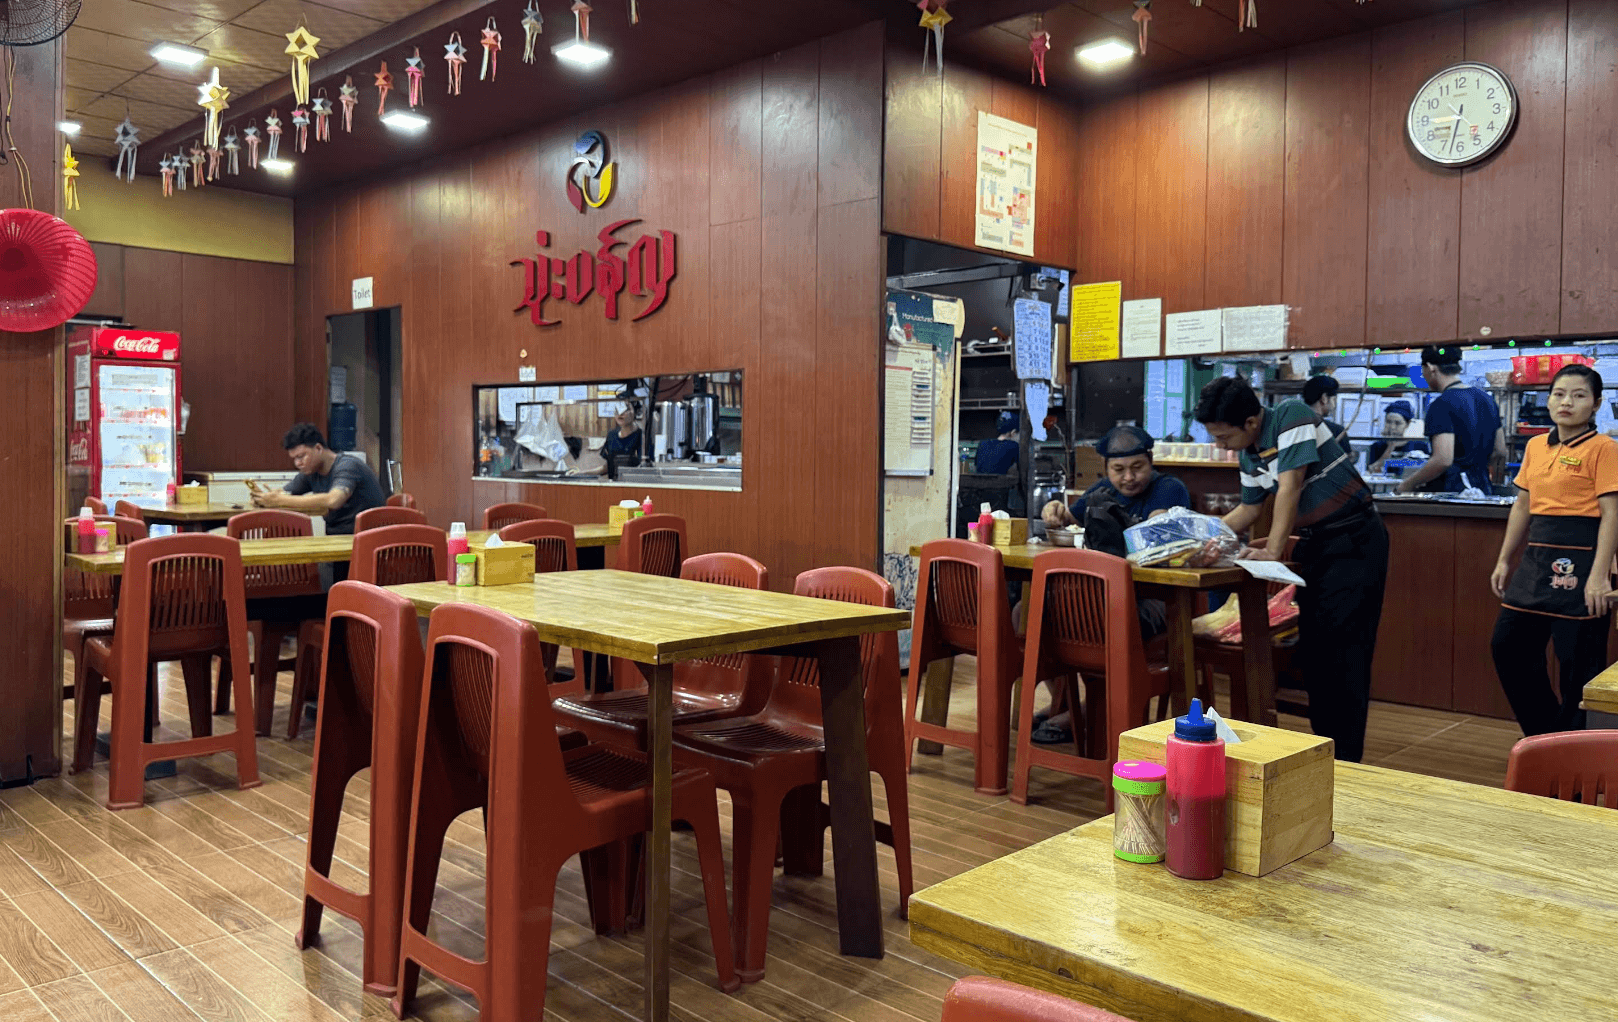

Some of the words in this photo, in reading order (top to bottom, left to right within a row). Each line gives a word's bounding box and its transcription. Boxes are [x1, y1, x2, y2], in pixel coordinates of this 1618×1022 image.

[1455, 77, 1467, 90] 12
[1476, 78, 1480, 90] 1
[1439, 84, 1449, 97] 11
[1486, 88, 1495, 100] 2
[1427, 98, 1439, 110] 10
[1492, 103, 1501, 115] 3
[1421, 115, 1430, 127] 9
[1486, 121, 1495, 132] 4
[1427, 131, 1436, 142] 8
[1473, 135, 1482, 146] 5
[1441, 140, 1448, 152] 7
[1456, 142, 1465, 153] 6
[353, 287, 371, 300] Toilet
